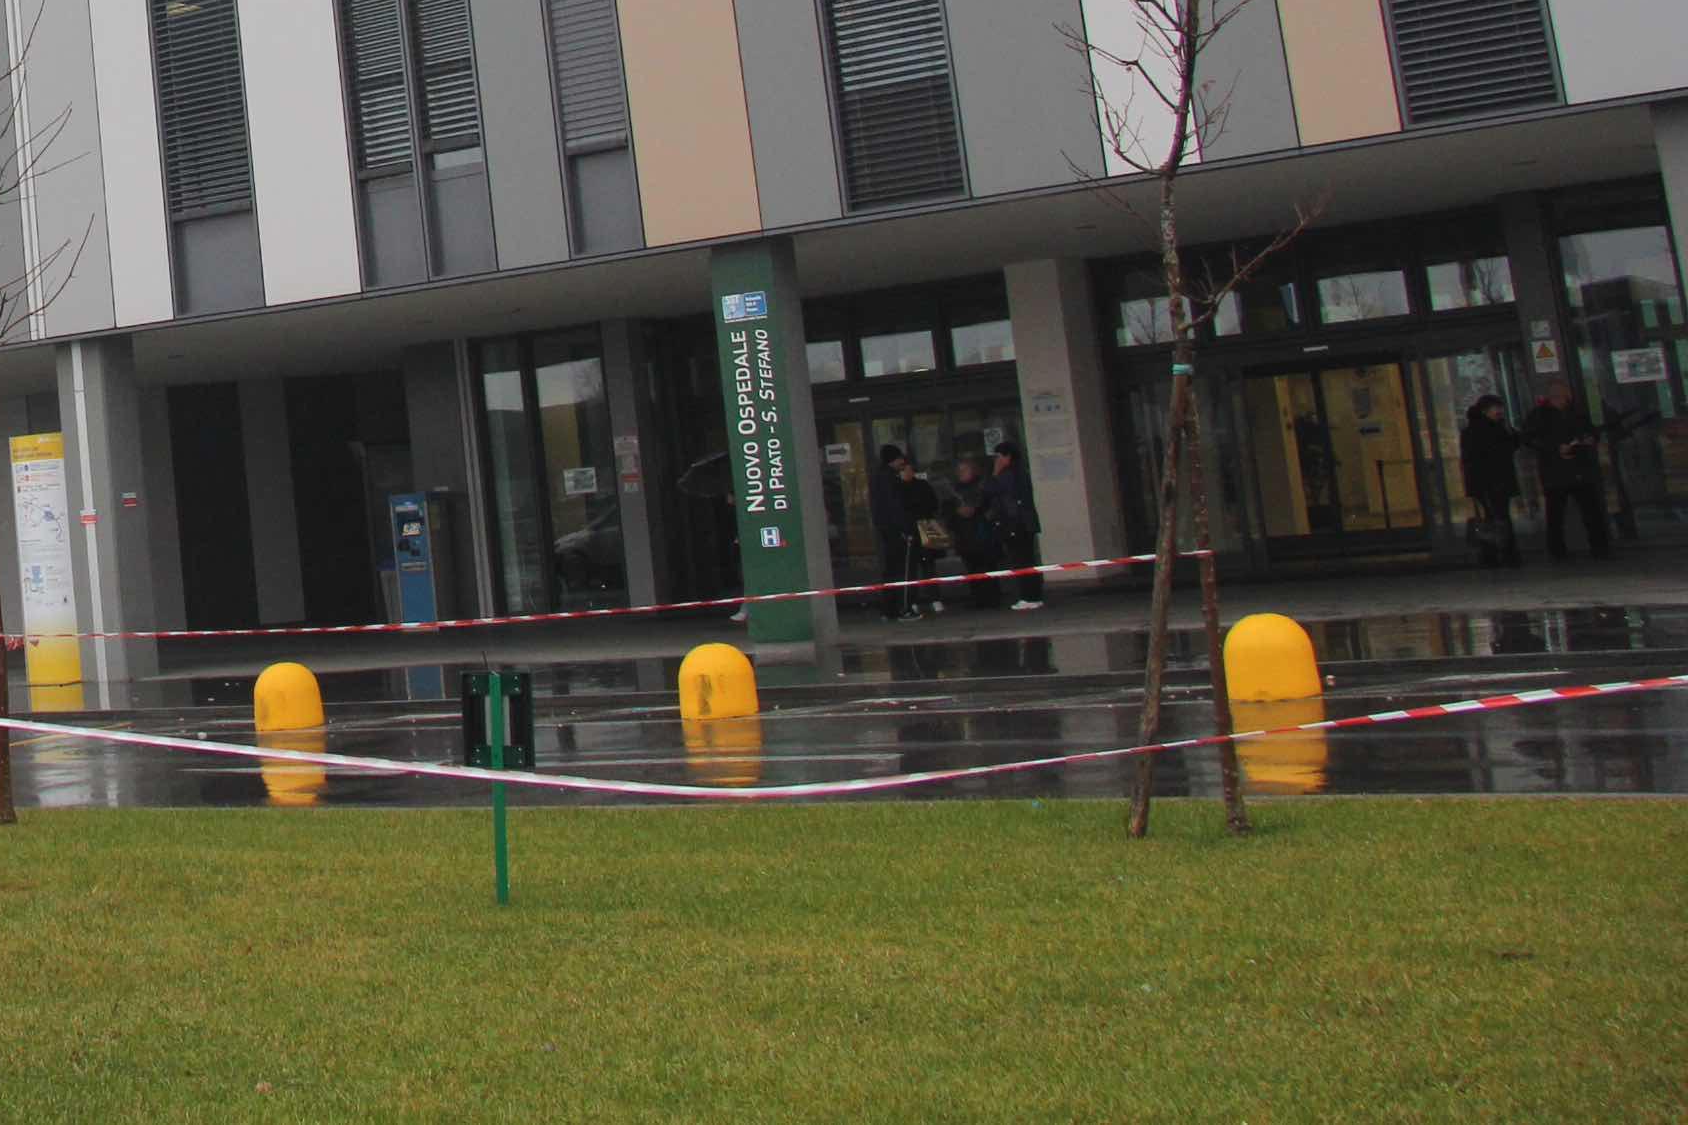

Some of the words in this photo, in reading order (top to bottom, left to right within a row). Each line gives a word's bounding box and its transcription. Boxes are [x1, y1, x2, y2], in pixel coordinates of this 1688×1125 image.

[730, 330, 756, 435] OSPEDALE
[755, 329, 775, 401] STEFANO
[761, 406, 777, 423] S.
[743, 441, 766, 512] NUOVO
[767, 438, 785, 490] PRATO
